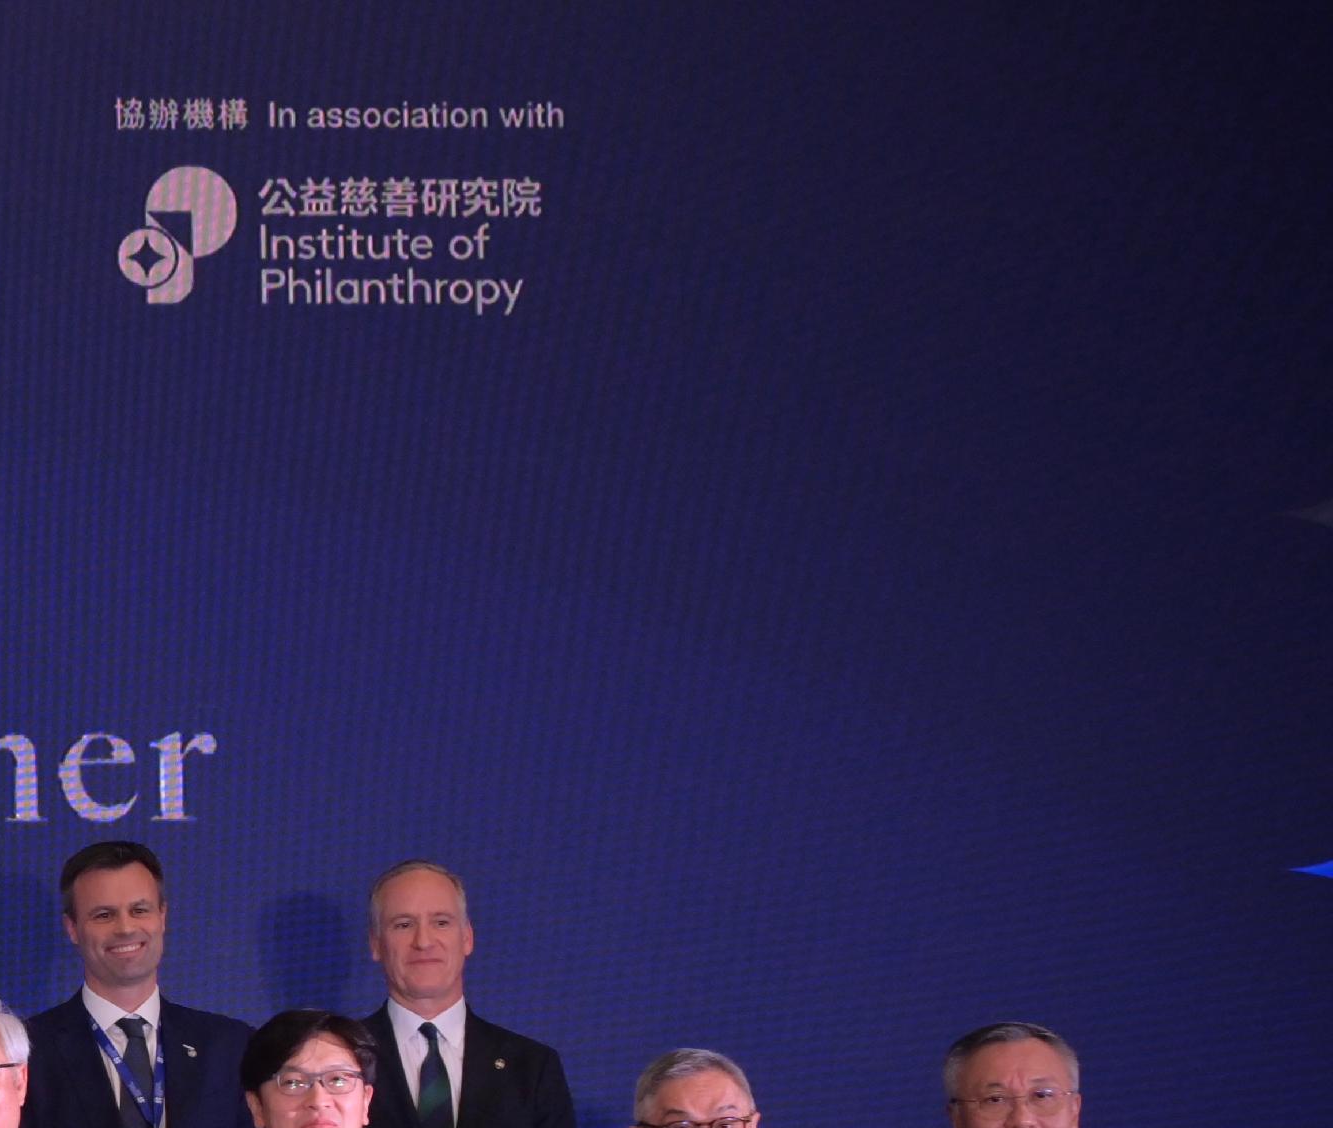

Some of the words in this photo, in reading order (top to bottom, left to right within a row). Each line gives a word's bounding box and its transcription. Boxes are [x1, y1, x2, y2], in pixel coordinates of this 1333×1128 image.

[114, 97, 248, 130] 協辦機構
[269, 100, 297, 129] In
[306, 100, 488, 129] association
[499, 101, 564, 128] with
[258, 176, 542, 218] 公益慈善研究院
[260, 223, 434, 260] Institute
[448, 222, 490, 260] of
[260, 266, 523, 316] Philanthropy
